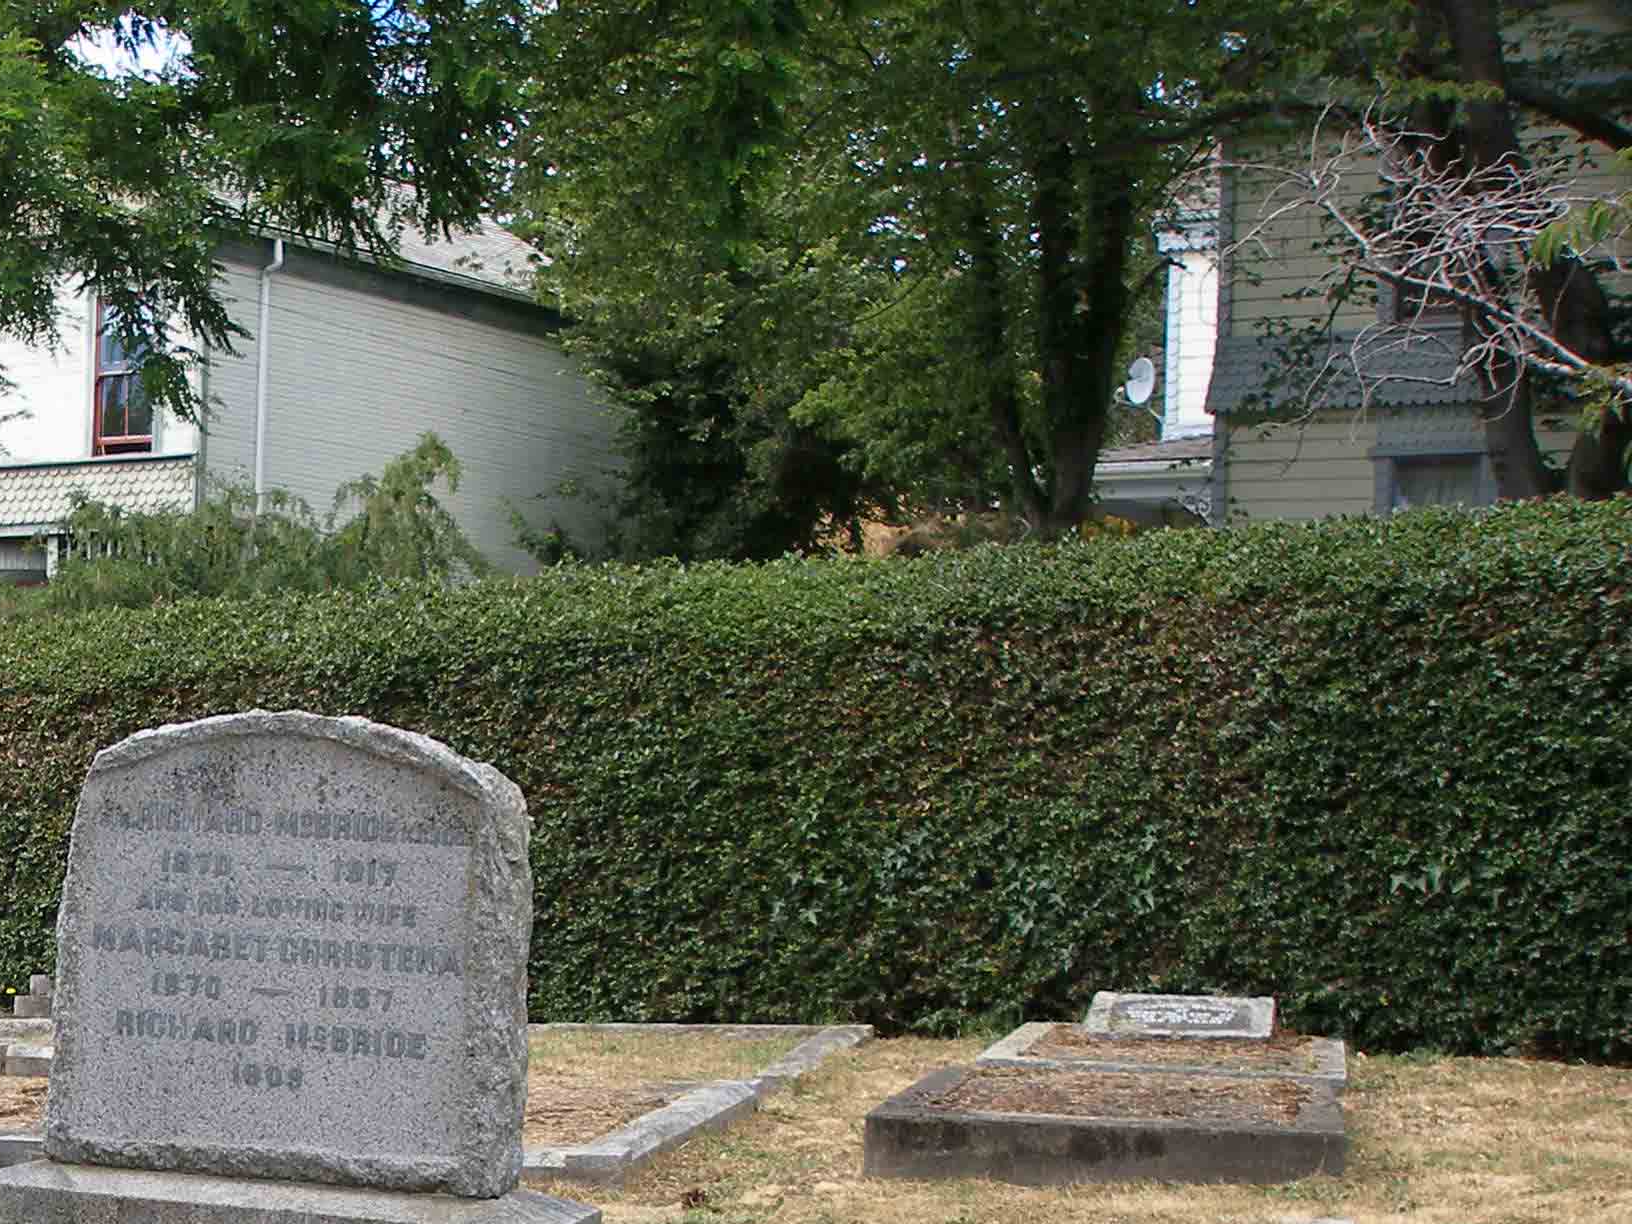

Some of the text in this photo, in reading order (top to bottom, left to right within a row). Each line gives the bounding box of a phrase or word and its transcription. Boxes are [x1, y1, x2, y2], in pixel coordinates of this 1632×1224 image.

[161, 849, 232, 876] 1870
[250, 895, 345, 922] LOVING
[353, 902, 417, 929] WIFE
[92, 924, 270, 963] MARGARET
[151, 972, 222, 1000] 1870
[115, 1009, 428, 1061] RICHARD McBRIDE
